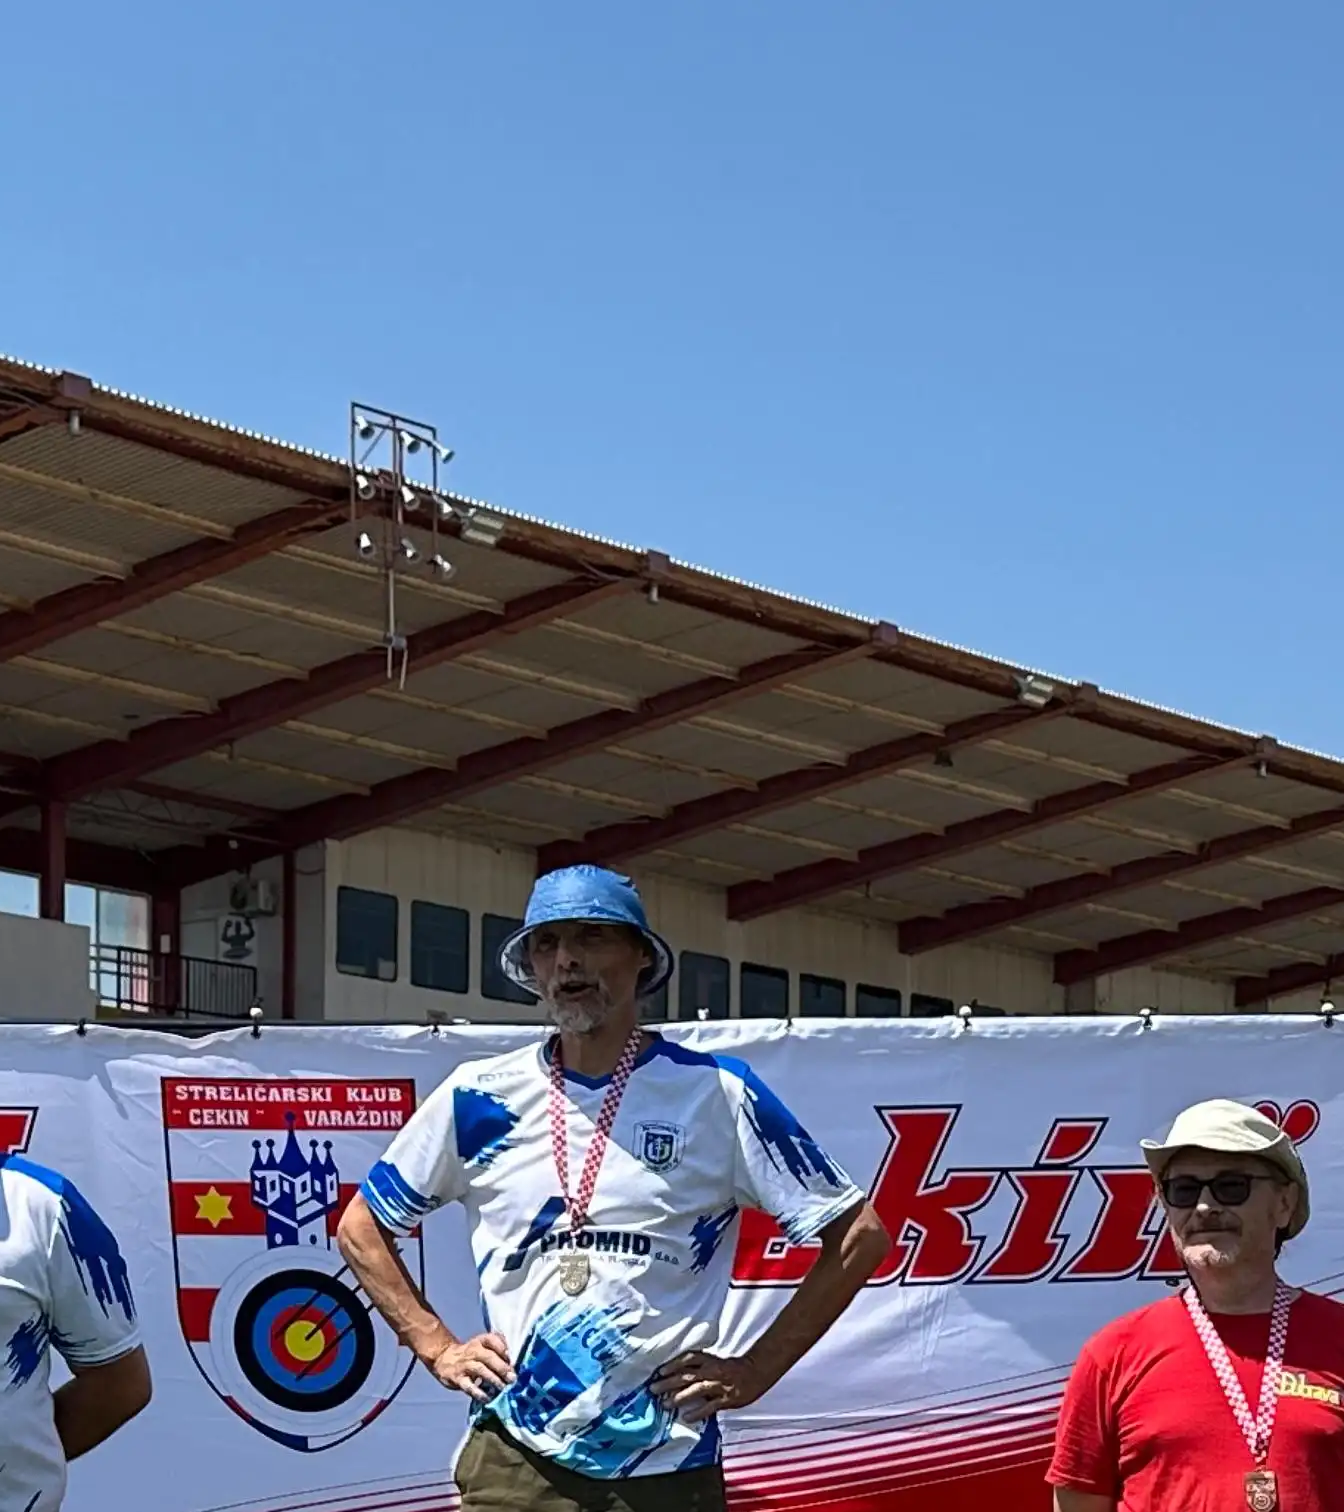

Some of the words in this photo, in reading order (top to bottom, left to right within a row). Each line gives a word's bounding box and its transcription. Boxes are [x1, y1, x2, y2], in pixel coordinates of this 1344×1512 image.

[174, 1083, 333, 1103] STRELIČARSKI
[345, 1086, 403, 1103] KLUB
[303, 1106, 404, 1128] VARAŽDIN
